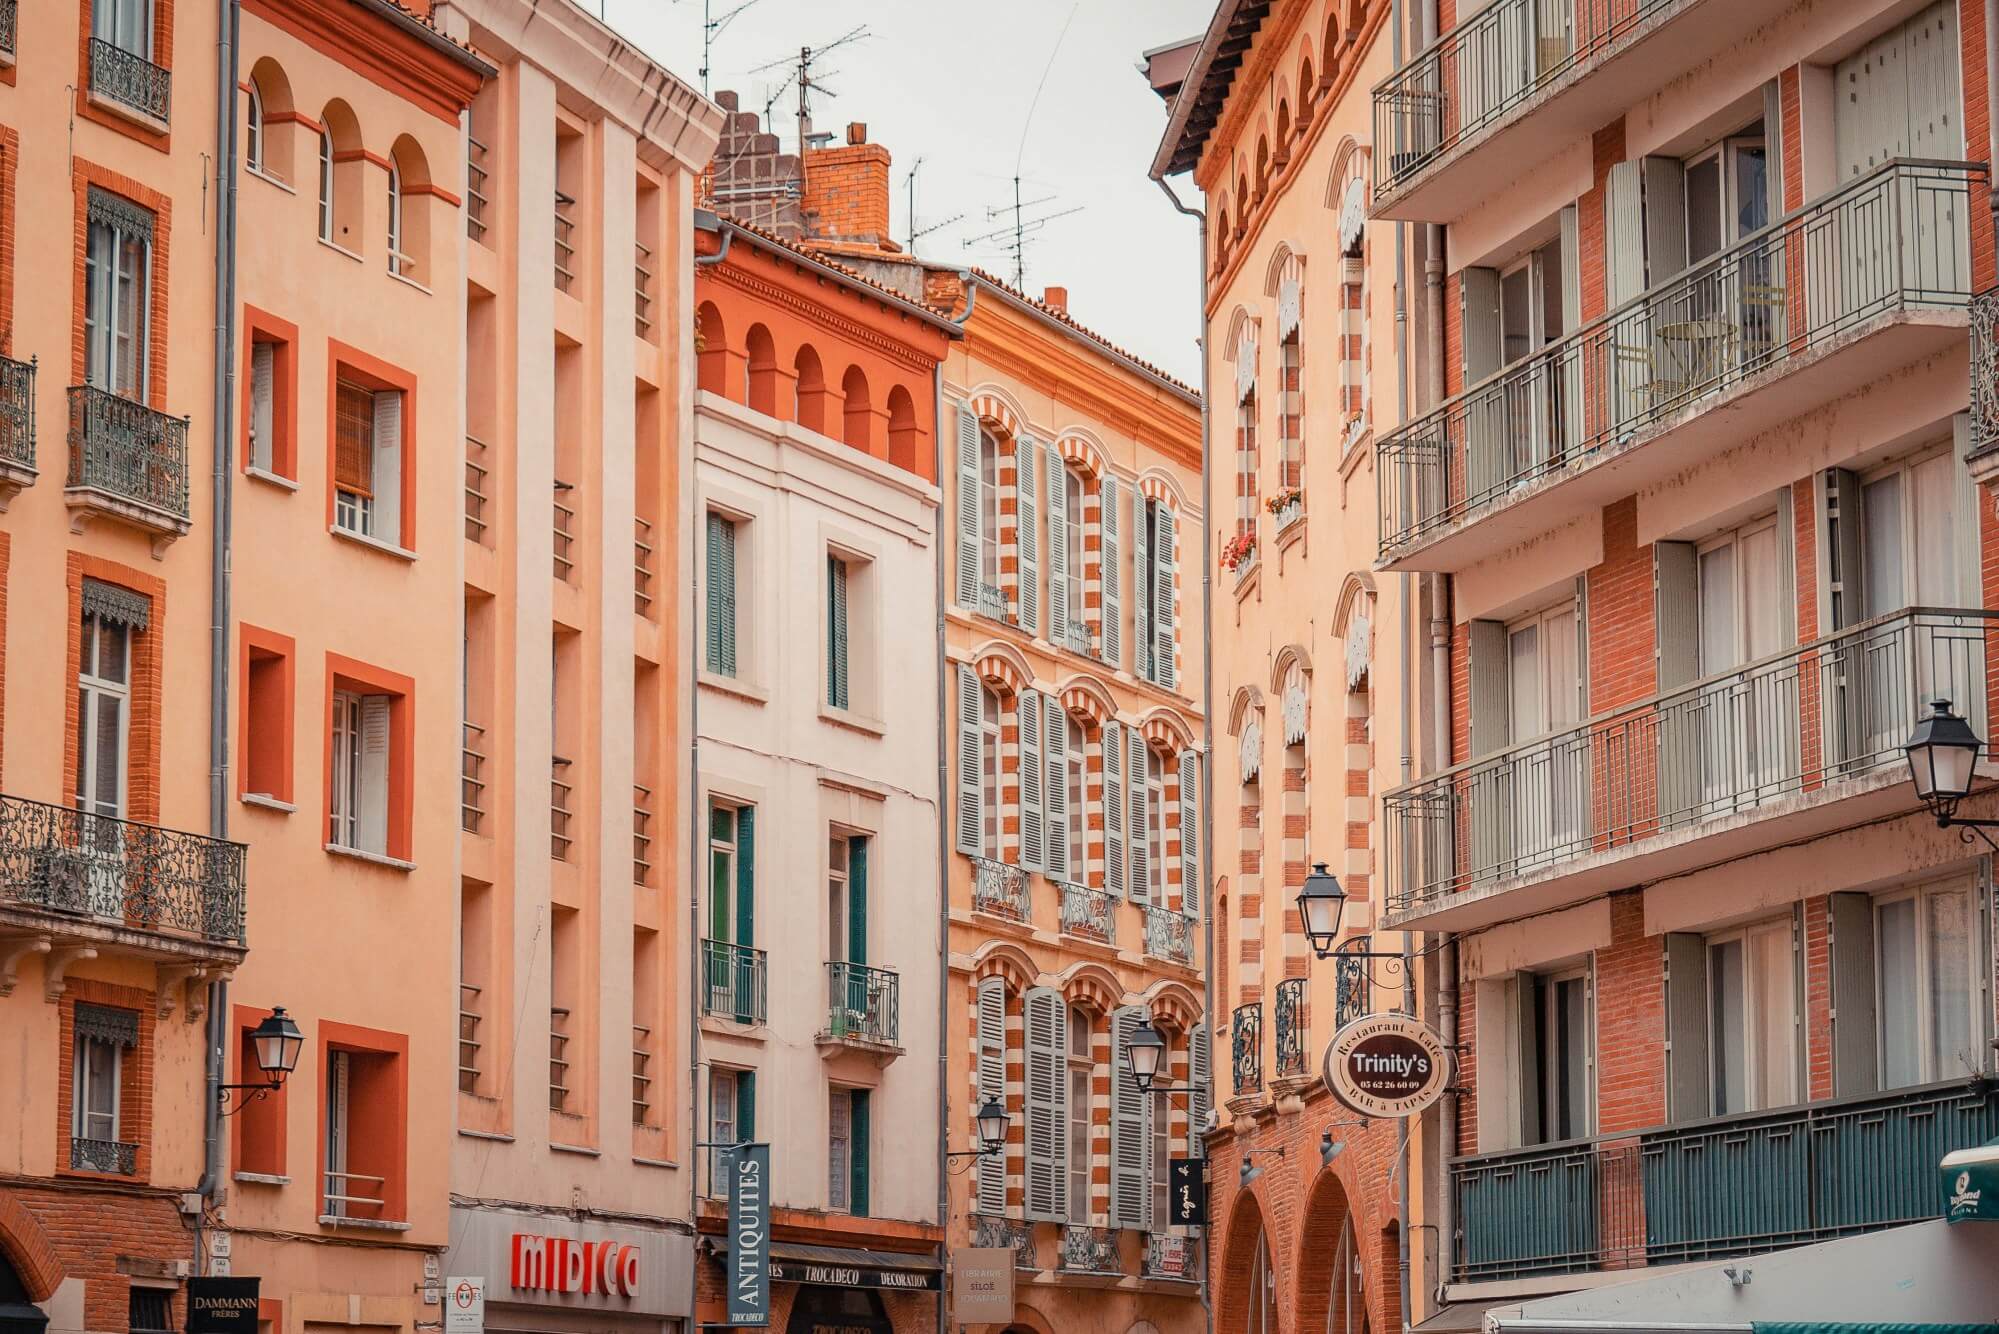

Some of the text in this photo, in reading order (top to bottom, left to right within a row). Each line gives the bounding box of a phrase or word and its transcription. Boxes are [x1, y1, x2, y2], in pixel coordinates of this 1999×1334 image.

[1337, 1022, 1405, 1056] Restaurant
[1418, 1031, 1443, 1057] Café
[1352, 1053, 1428, 1078] Trinity's
[1360, 1081, 1420, 1089] 05 62 26 60 09
[1348, 1088, 1374, 1109] BAR
[1395, 1089, 1432, 1112] TAPAS
[738, 1159, 764, 1307] ANTIQUITES
[804, 1265, 860, 1285] TROCADECO
[880, 1271, 928, 1288] DECORATION
[195, 1297, 257, 1309] DAMMANN
